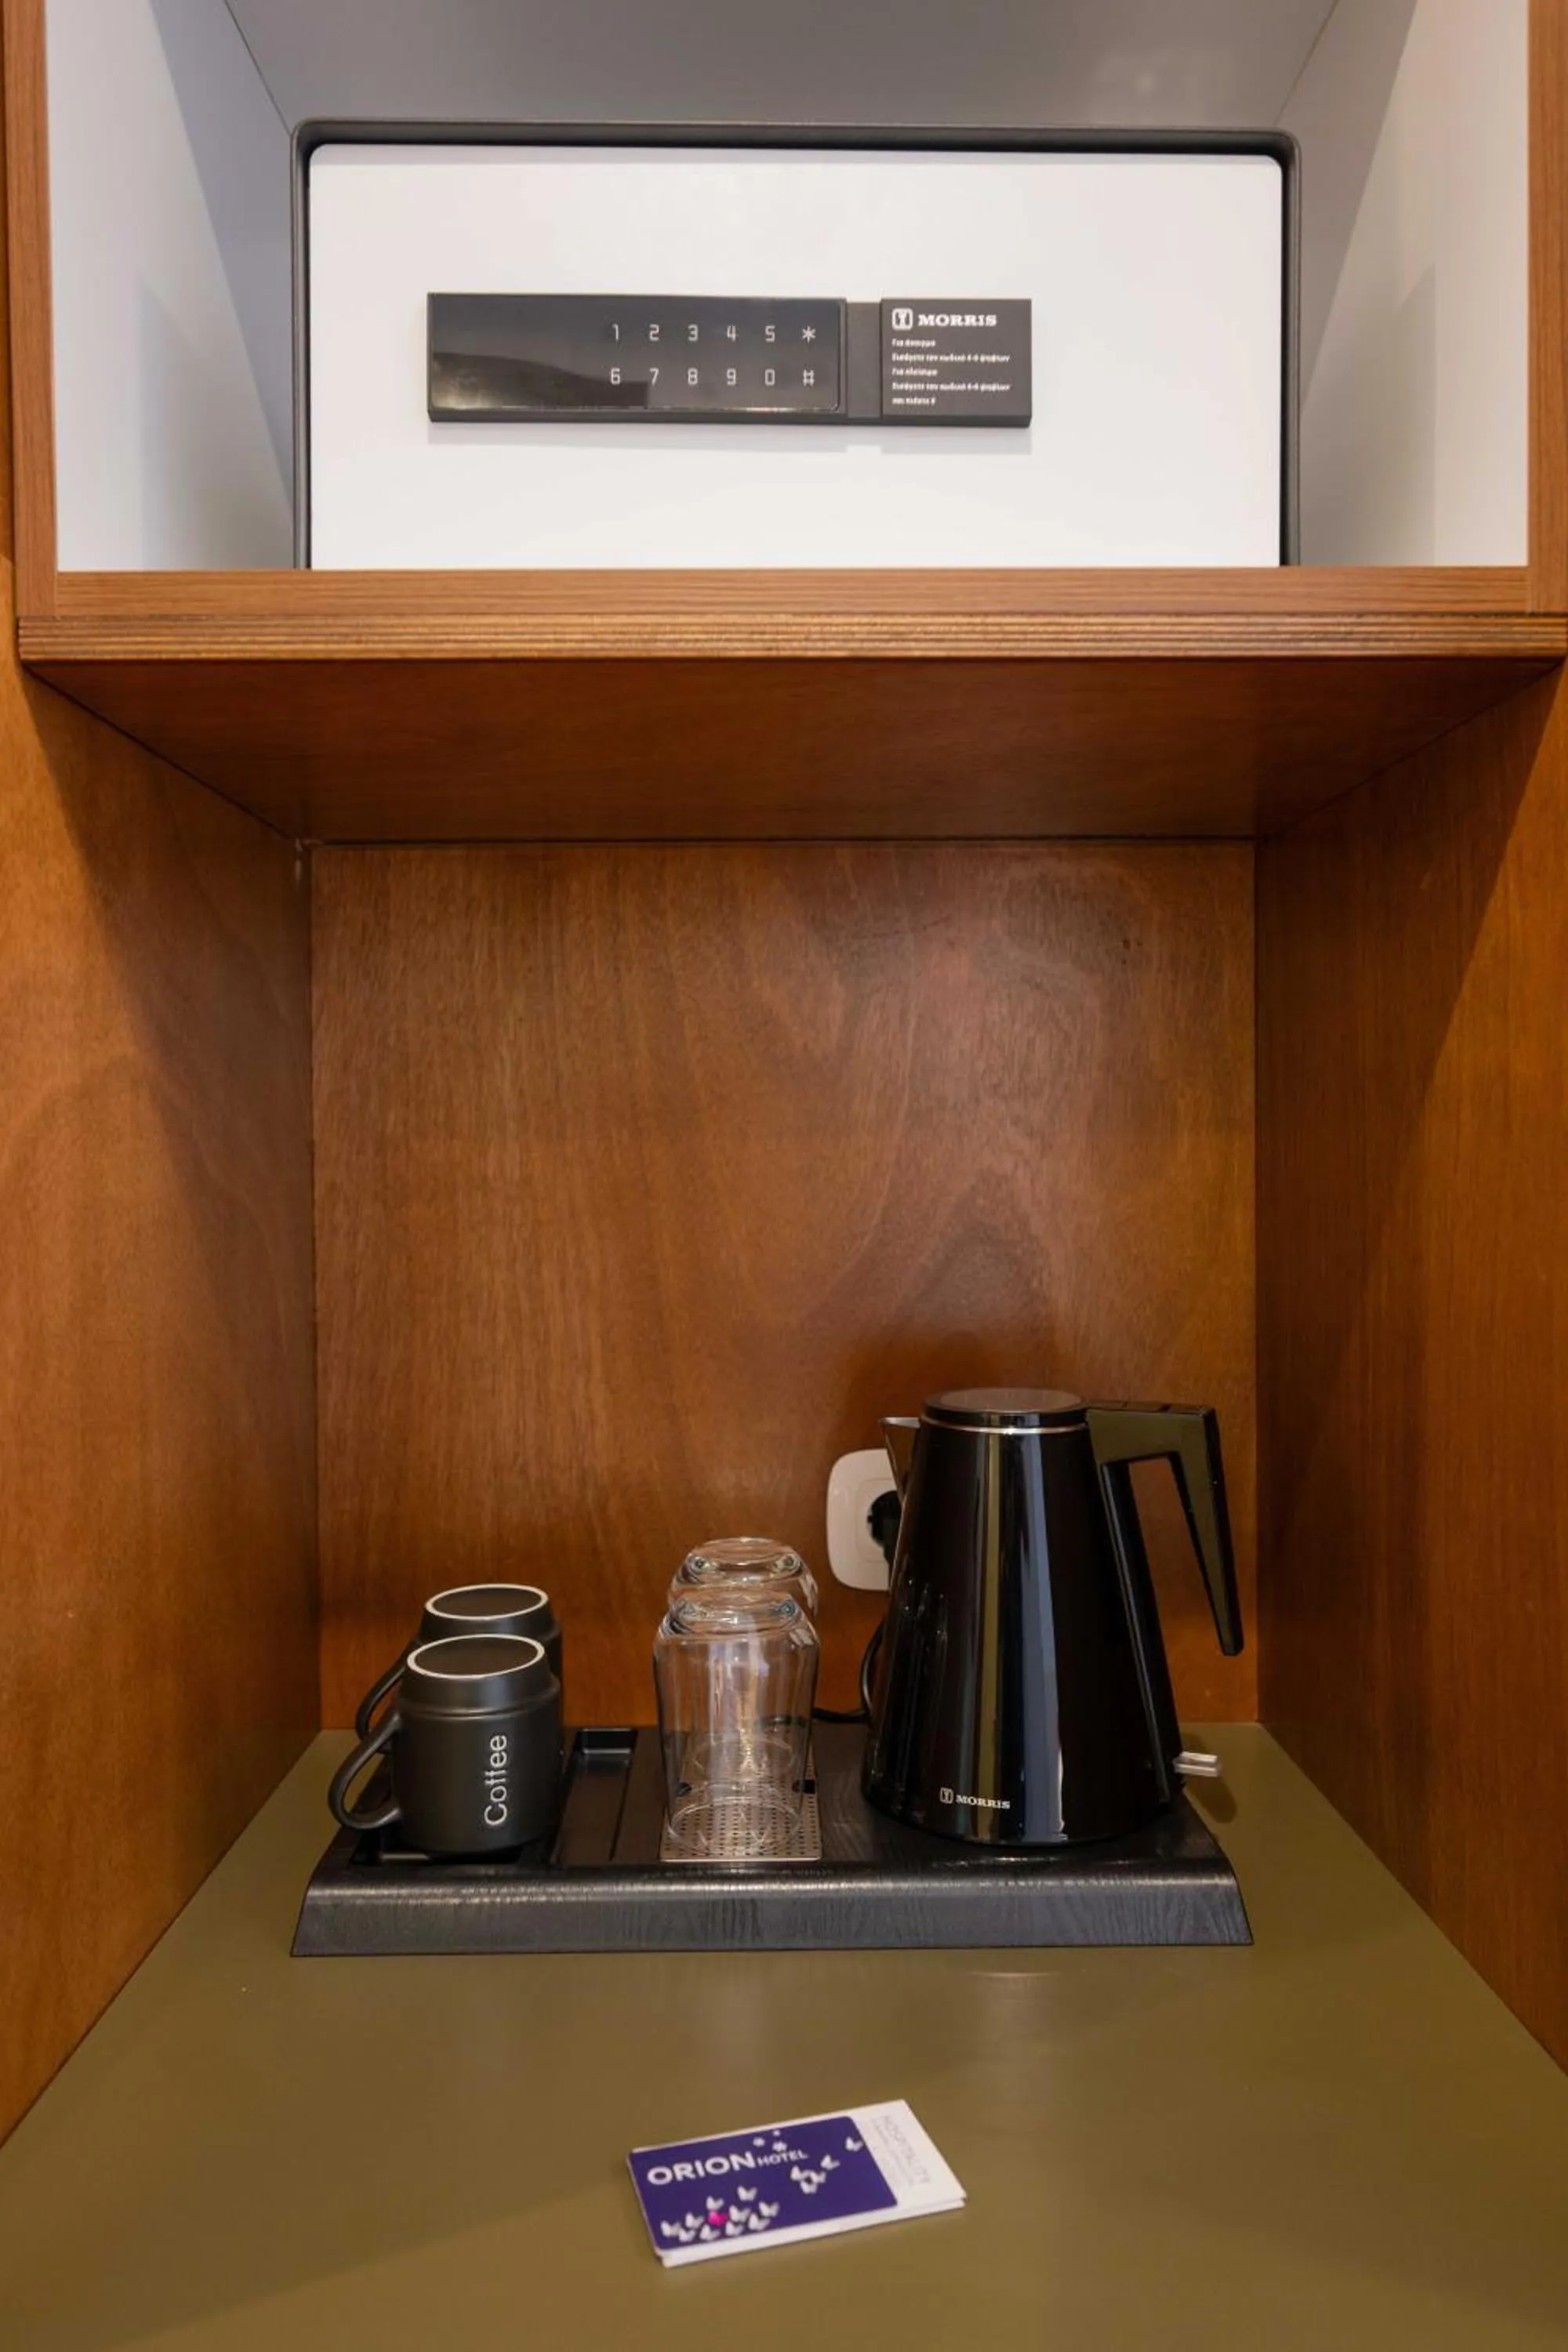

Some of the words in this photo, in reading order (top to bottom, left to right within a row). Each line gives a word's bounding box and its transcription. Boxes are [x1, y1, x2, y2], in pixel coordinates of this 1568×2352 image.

[917, 314, 997, 327] MORRIS
[612, 324, 619, 342] 1
[648, 324, 659, 342] 2
[688, 324, 699, 342] 3
[726, 324, 737, 342] 4
[764, 325, 775, 343] 5
[610, 368, 621, 385] 6
[649, 368, 659, 385] 7
[688, 368, 699, 385] 8
[726, 368, 737, 385] 9
[764, 368, 775, 386] 0
[484, 1734, 508, 1826] Coffee
[955, 1794, 1011, 1809] MORRIS
[647, 2150, 757, 2186] ORION
[757, 2147, 810, 2169] HOTEL
